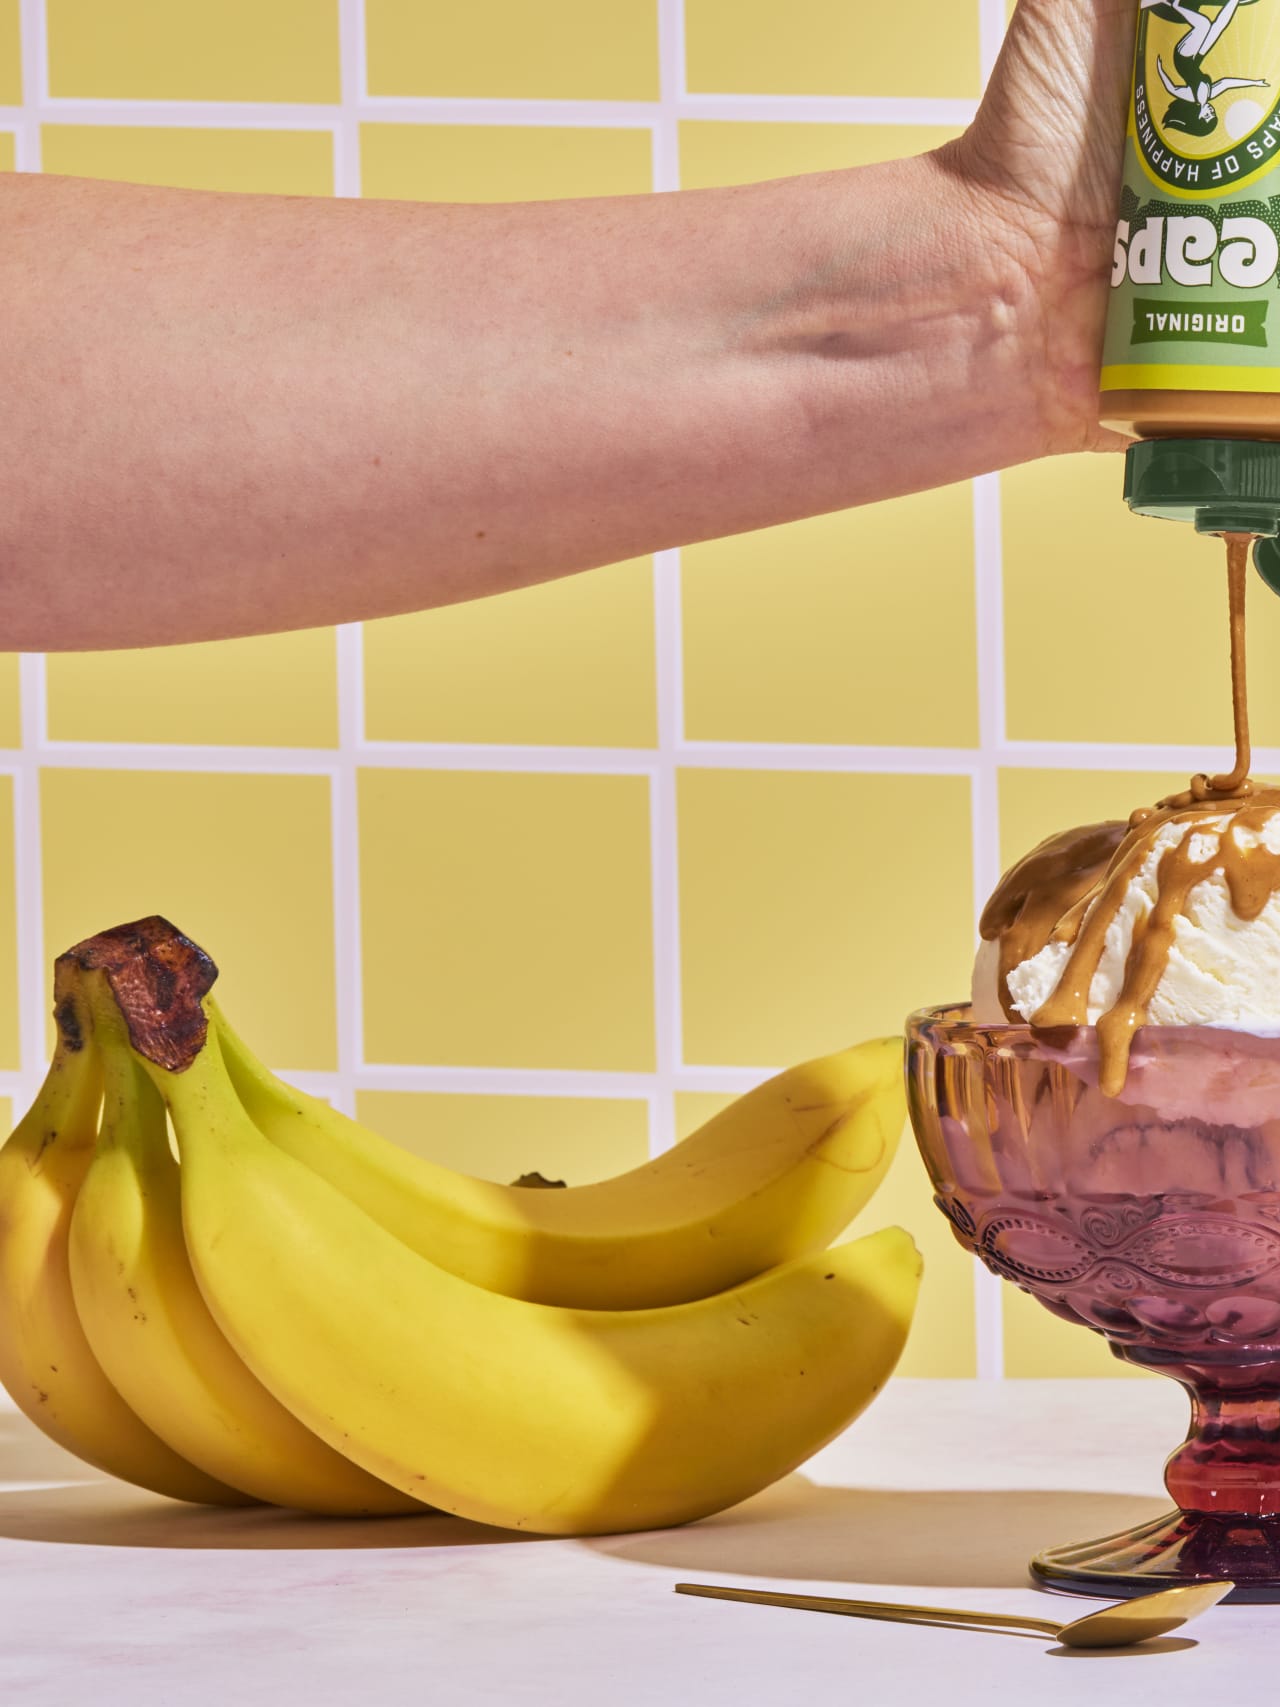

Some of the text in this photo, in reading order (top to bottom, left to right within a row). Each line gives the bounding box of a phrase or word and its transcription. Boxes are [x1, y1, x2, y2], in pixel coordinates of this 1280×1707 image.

[1136, 83, 1200, 182] HAPPINESS
[1211, 155, 1240, 180] OF
[1146, 313, 1245, 333] ORIGINAL
